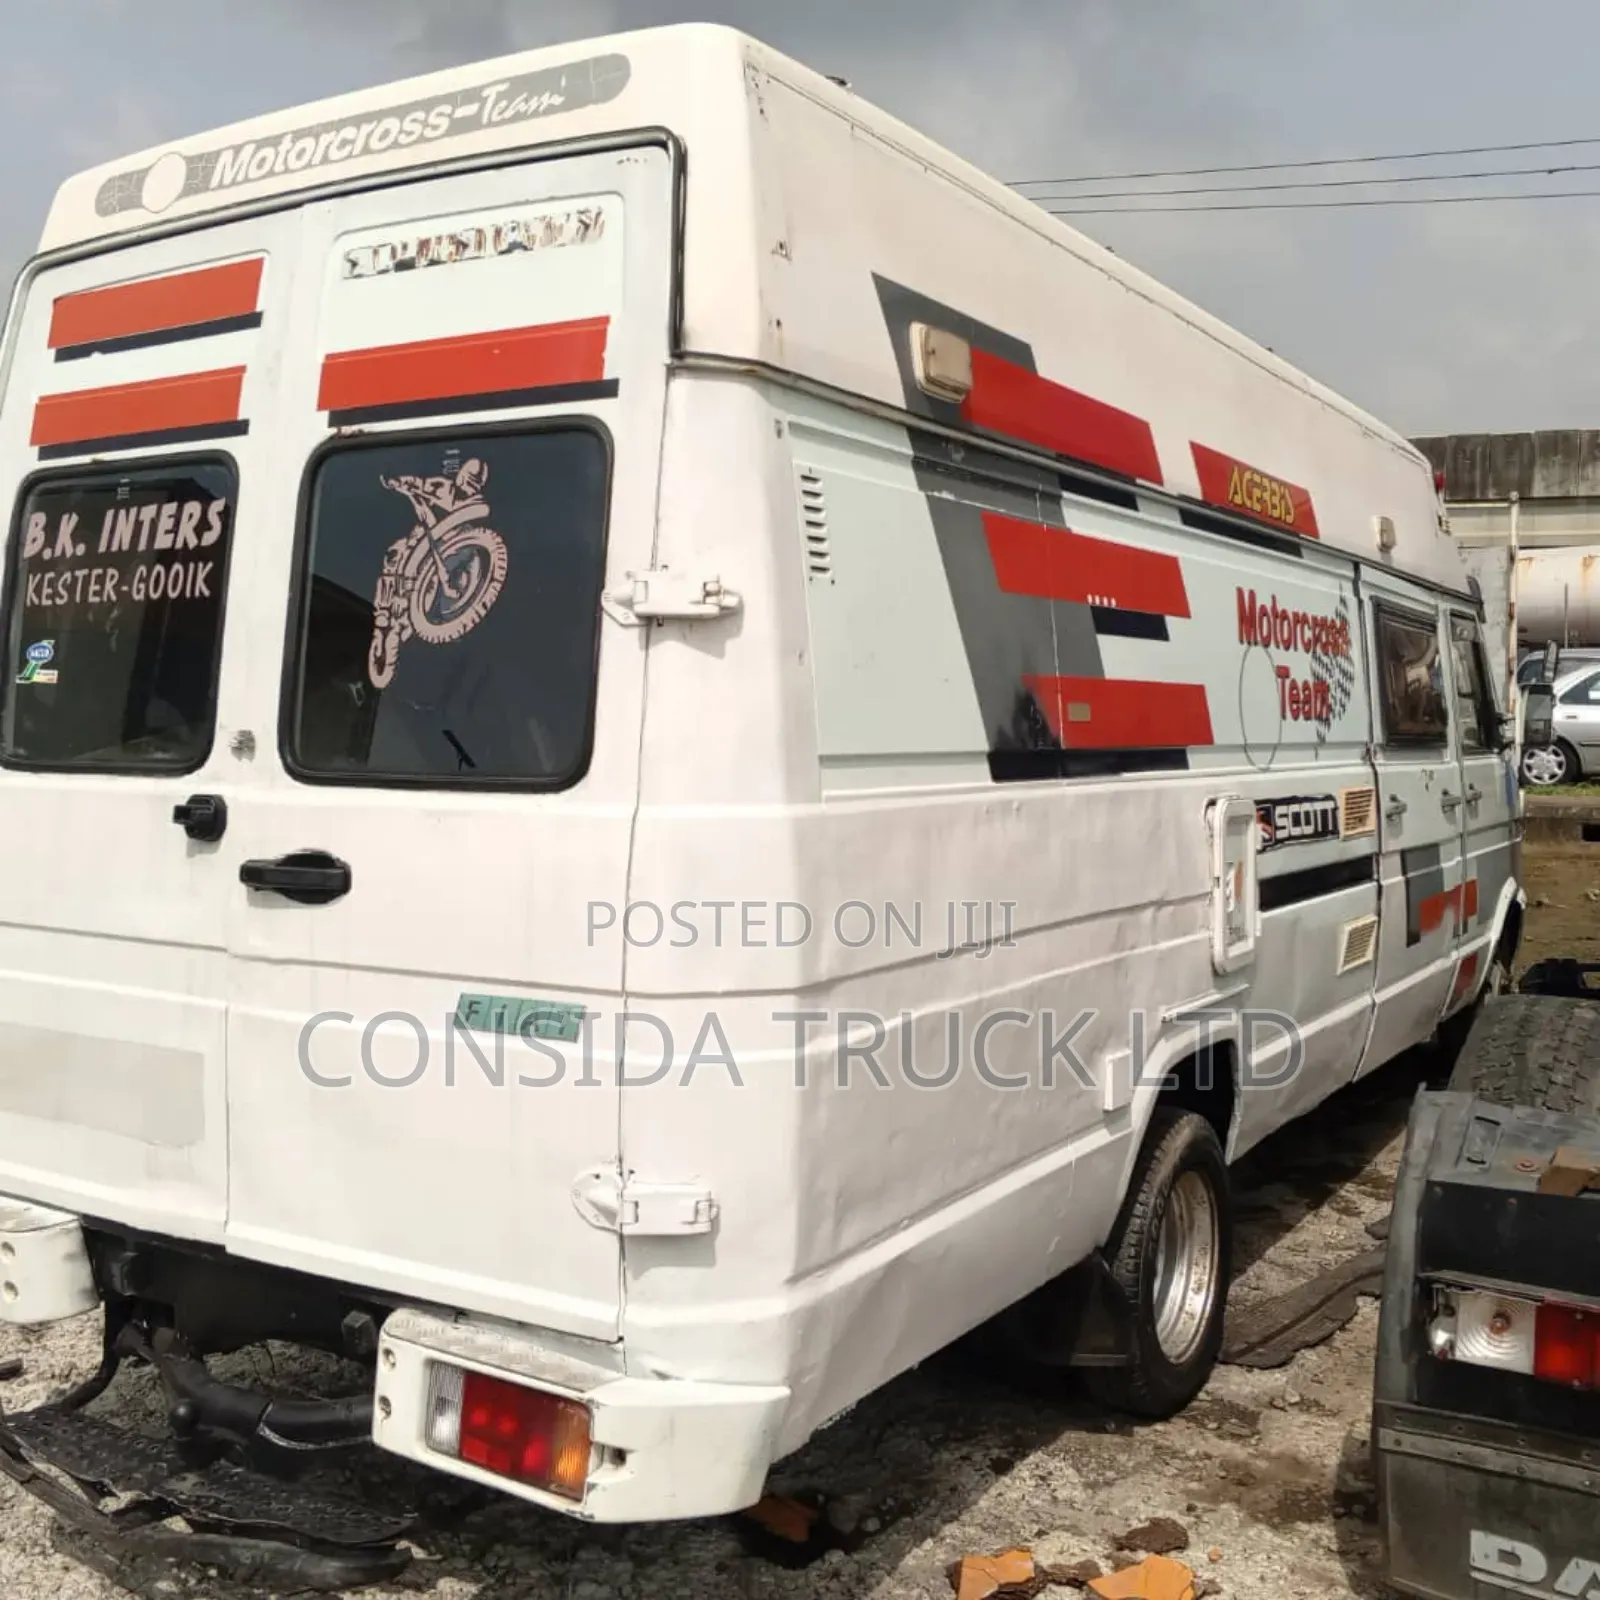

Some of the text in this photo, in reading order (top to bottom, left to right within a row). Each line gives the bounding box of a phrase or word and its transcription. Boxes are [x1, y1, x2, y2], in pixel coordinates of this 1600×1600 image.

[23, 497, 226, 560] B.K. INTERS
[26, 560, 213, 606] KESTER-GOOIK
[1275, 664, 1333, 722] Team
[1274, 800, 1336, 840] SCOTT
